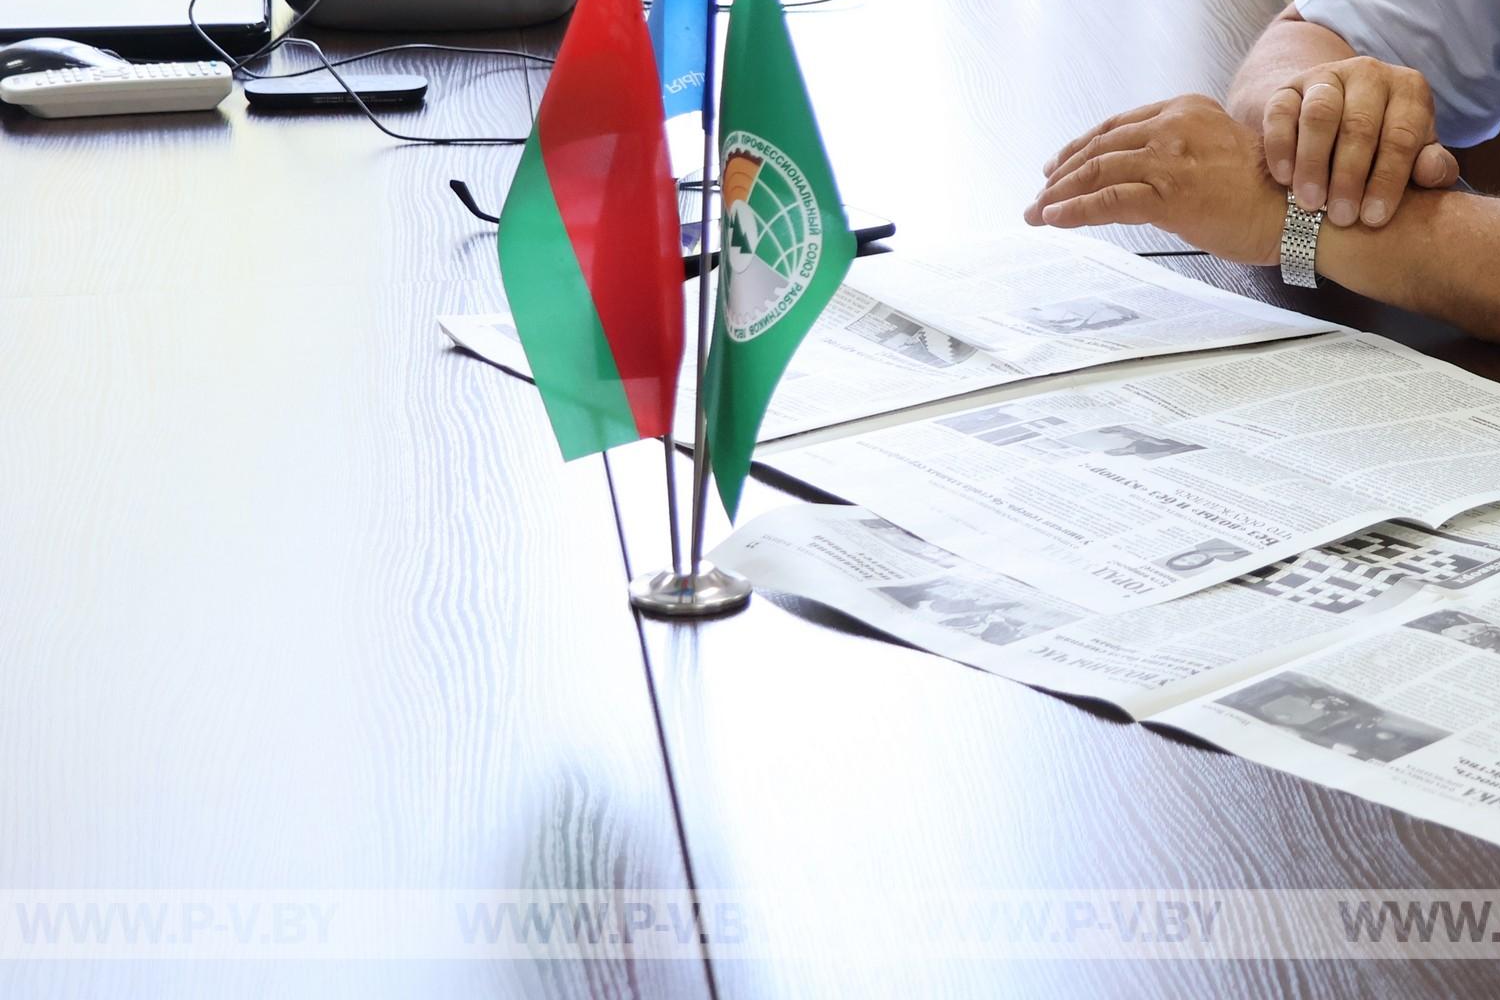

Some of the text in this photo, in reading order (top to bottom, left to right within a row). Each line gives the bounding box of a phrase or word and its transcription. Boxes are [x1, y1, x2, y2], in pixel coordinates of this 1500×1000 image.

[741, 133, 821, 236] ПРОФЕССИОНАЛЬНЫЙ
[799, 242, 820, 279] СОЮЗ
[748, 280, 803, 337] РАБОТНИКОВ
[1143, 491, 1178, 503] без
[1169, 488, 1296, 539] что обсуждалось
[1186, 508, 1250, 532] «воды»
[1246, 530, 1280, 545] Без
[1089, 566, 1154, 592] ГОРАД
[1030, 646, 1070, 662] ЧАС
[1069, 658, 1157, 680] ВОЛЬНЫ
